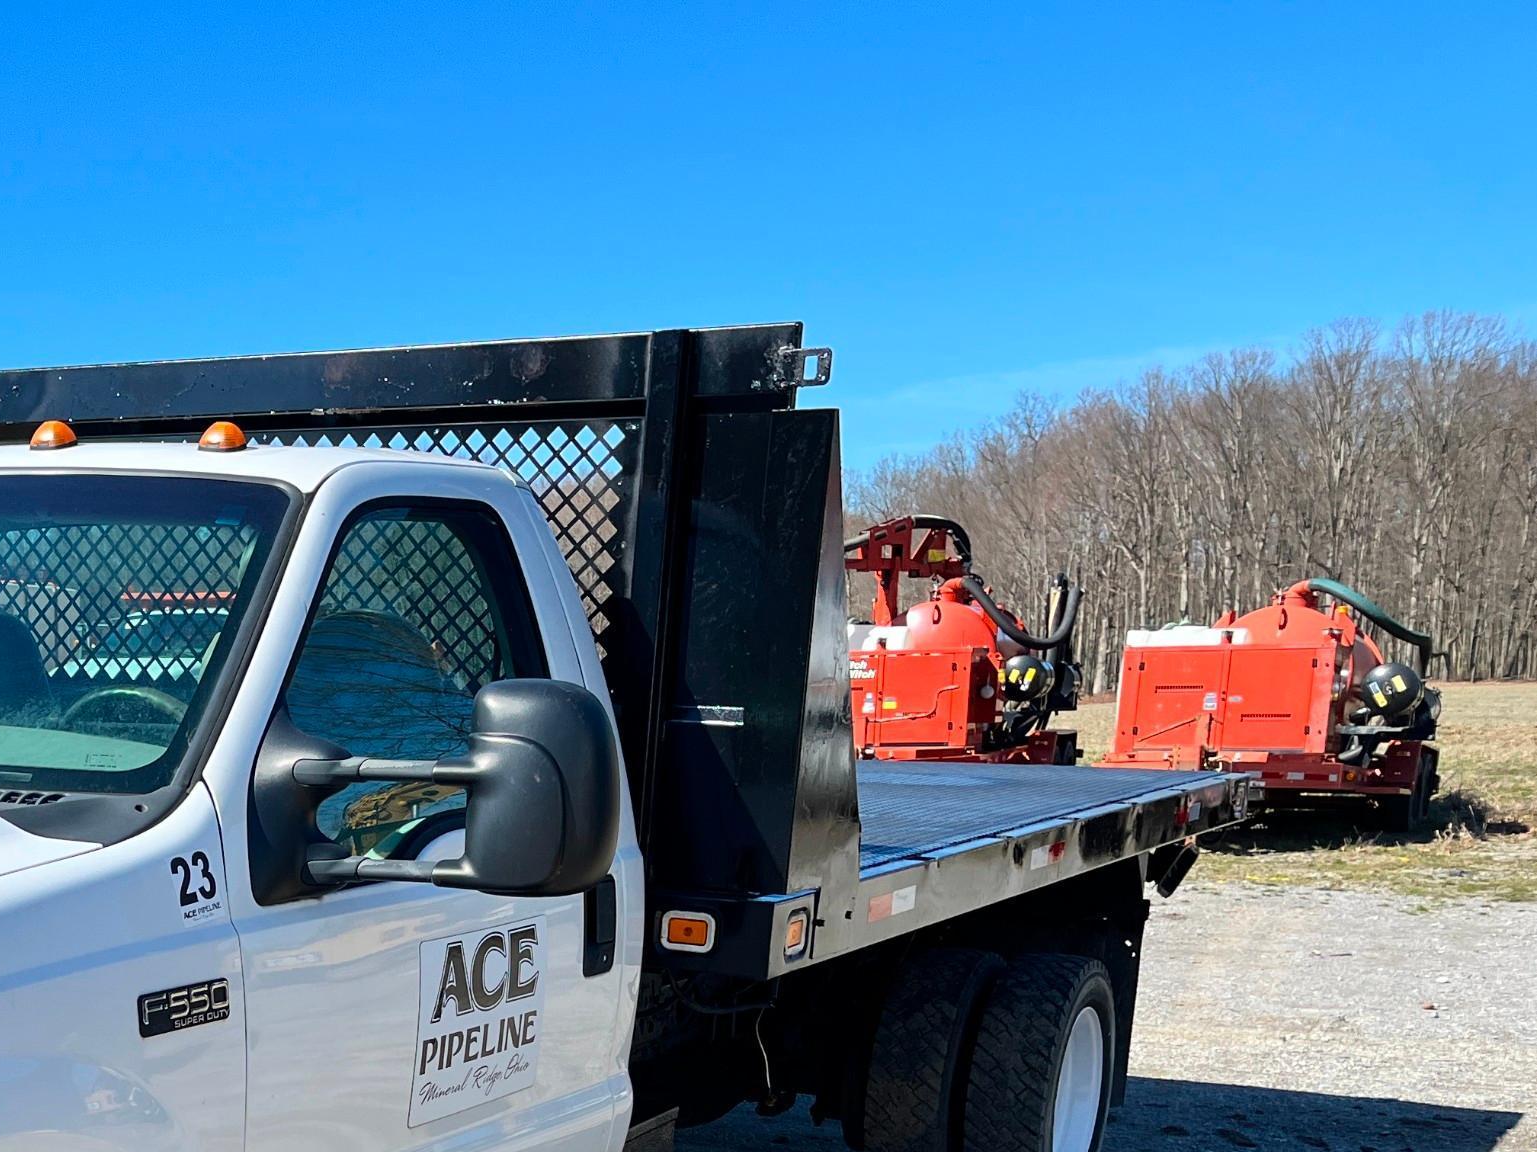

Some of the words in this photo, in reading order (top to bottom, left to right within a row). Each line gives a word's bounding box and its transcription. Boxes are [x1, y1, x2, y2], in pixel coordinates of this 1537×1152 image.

[170, 851, 216, 907] 23
[183, 909, 198, 920] ACE
[430, 924, 540, 1024] ACE
[174, 1014, 206, 1029] SUPER
[206, 1008, 230, 1021] DUTY
[419, 1010, 538, 1076] PIPELINE
[419, 1067, 473, 1105] Mineral
[503, 1053, 531, 1080] Ohio
